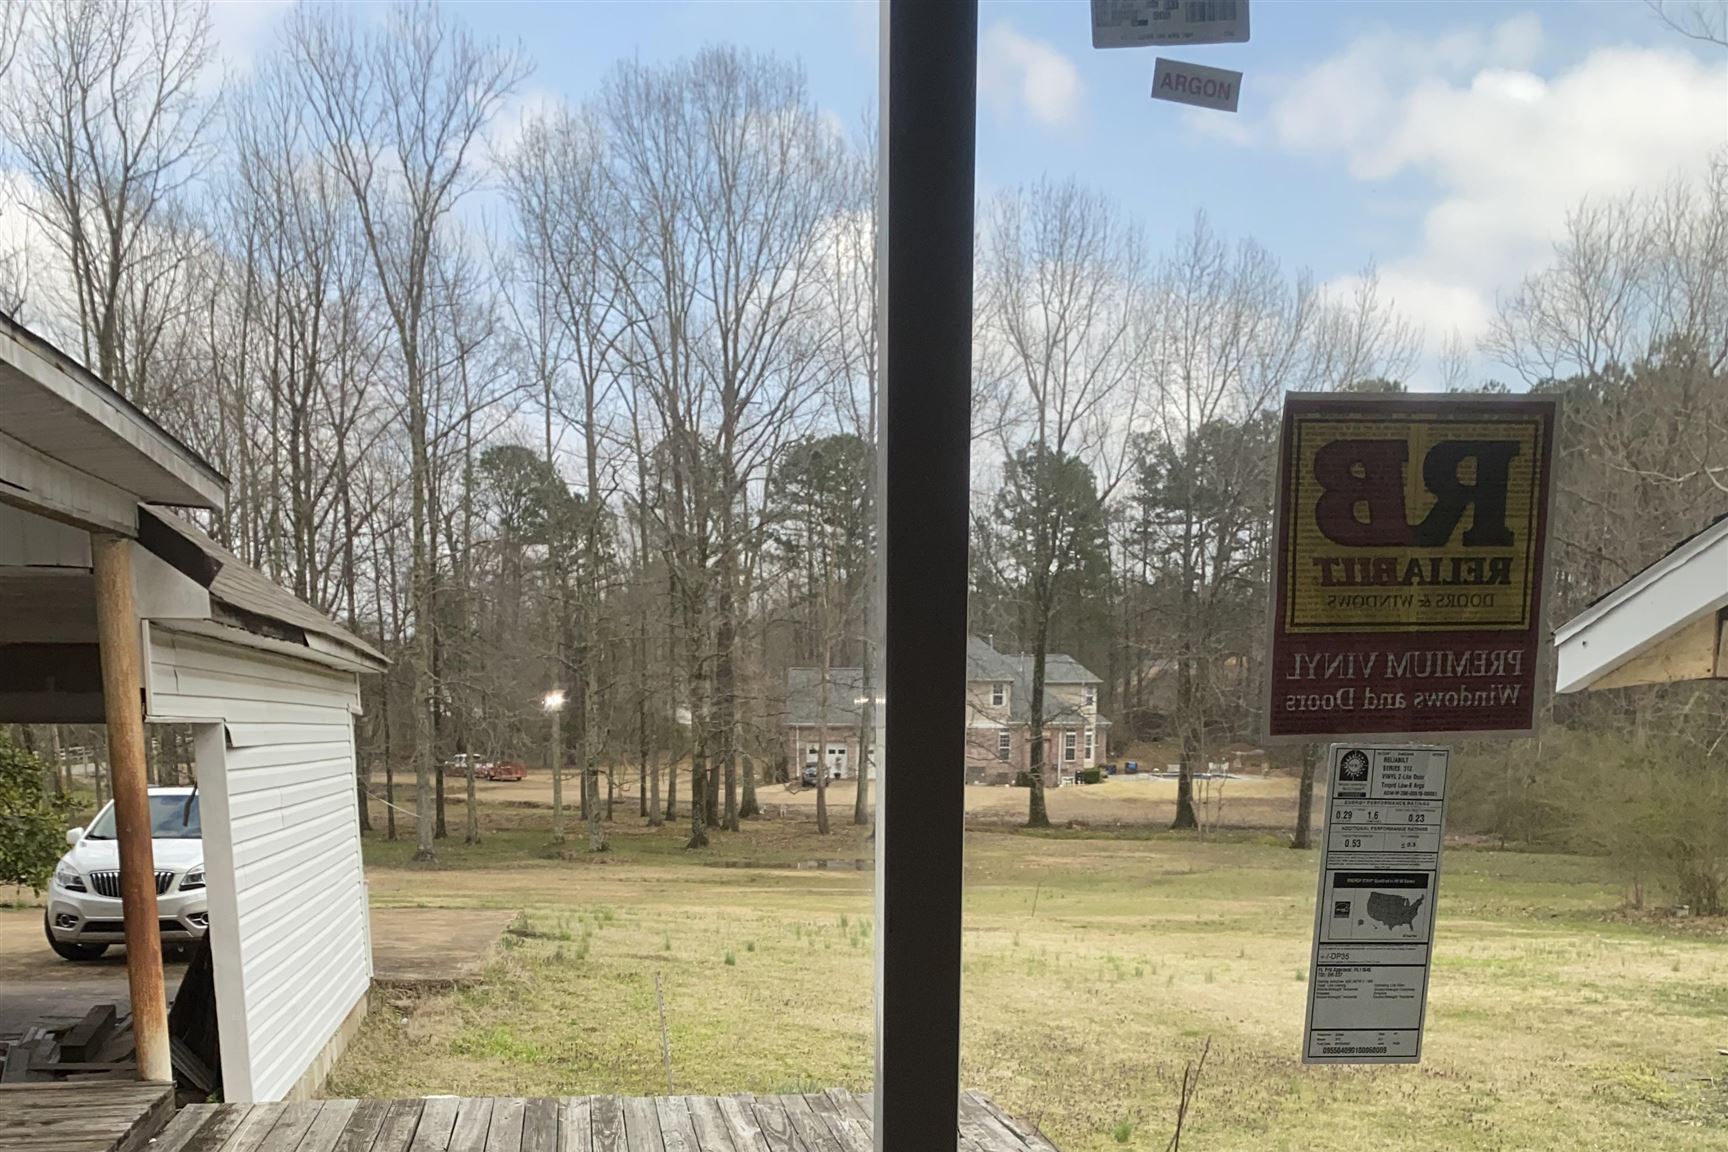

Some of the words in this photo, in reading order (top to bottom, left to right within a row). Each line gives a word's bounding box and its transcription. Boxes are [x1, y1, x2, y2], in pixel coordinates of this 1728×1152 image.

[1160, 71, 1232, 101] ARGON
[1335, 810, 1353, 820] 0.29
[1408, 813, 1425, 823] 0.23
[1344, 838, 1361, 848] 0.53
